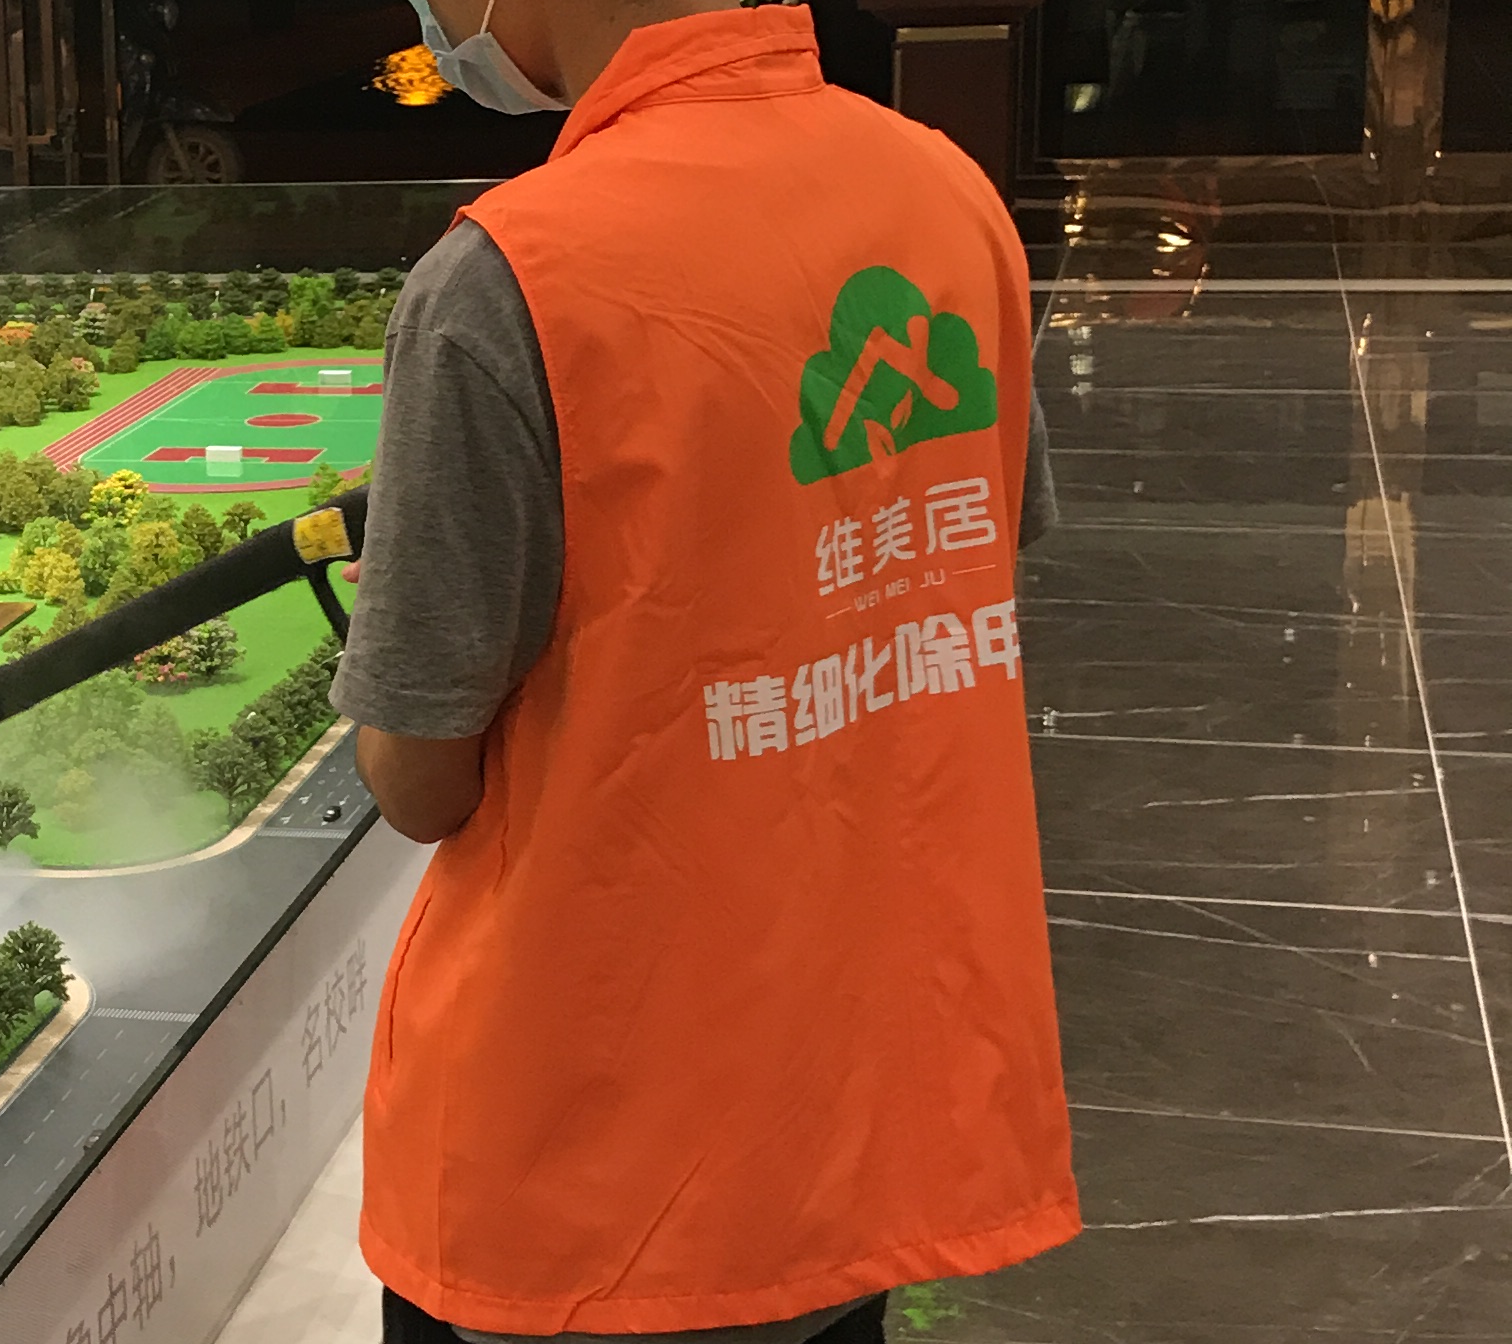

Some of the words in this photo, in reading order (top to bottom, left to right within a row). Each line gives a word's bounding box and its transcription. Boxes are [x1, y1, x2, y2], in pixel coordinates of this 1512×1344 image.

[815, 477, 997, 596] 维美居
[854, 591, 880, 613] WEI
[885, 577, 911, 599] MEI
[919, 569, 946, 589] JU
